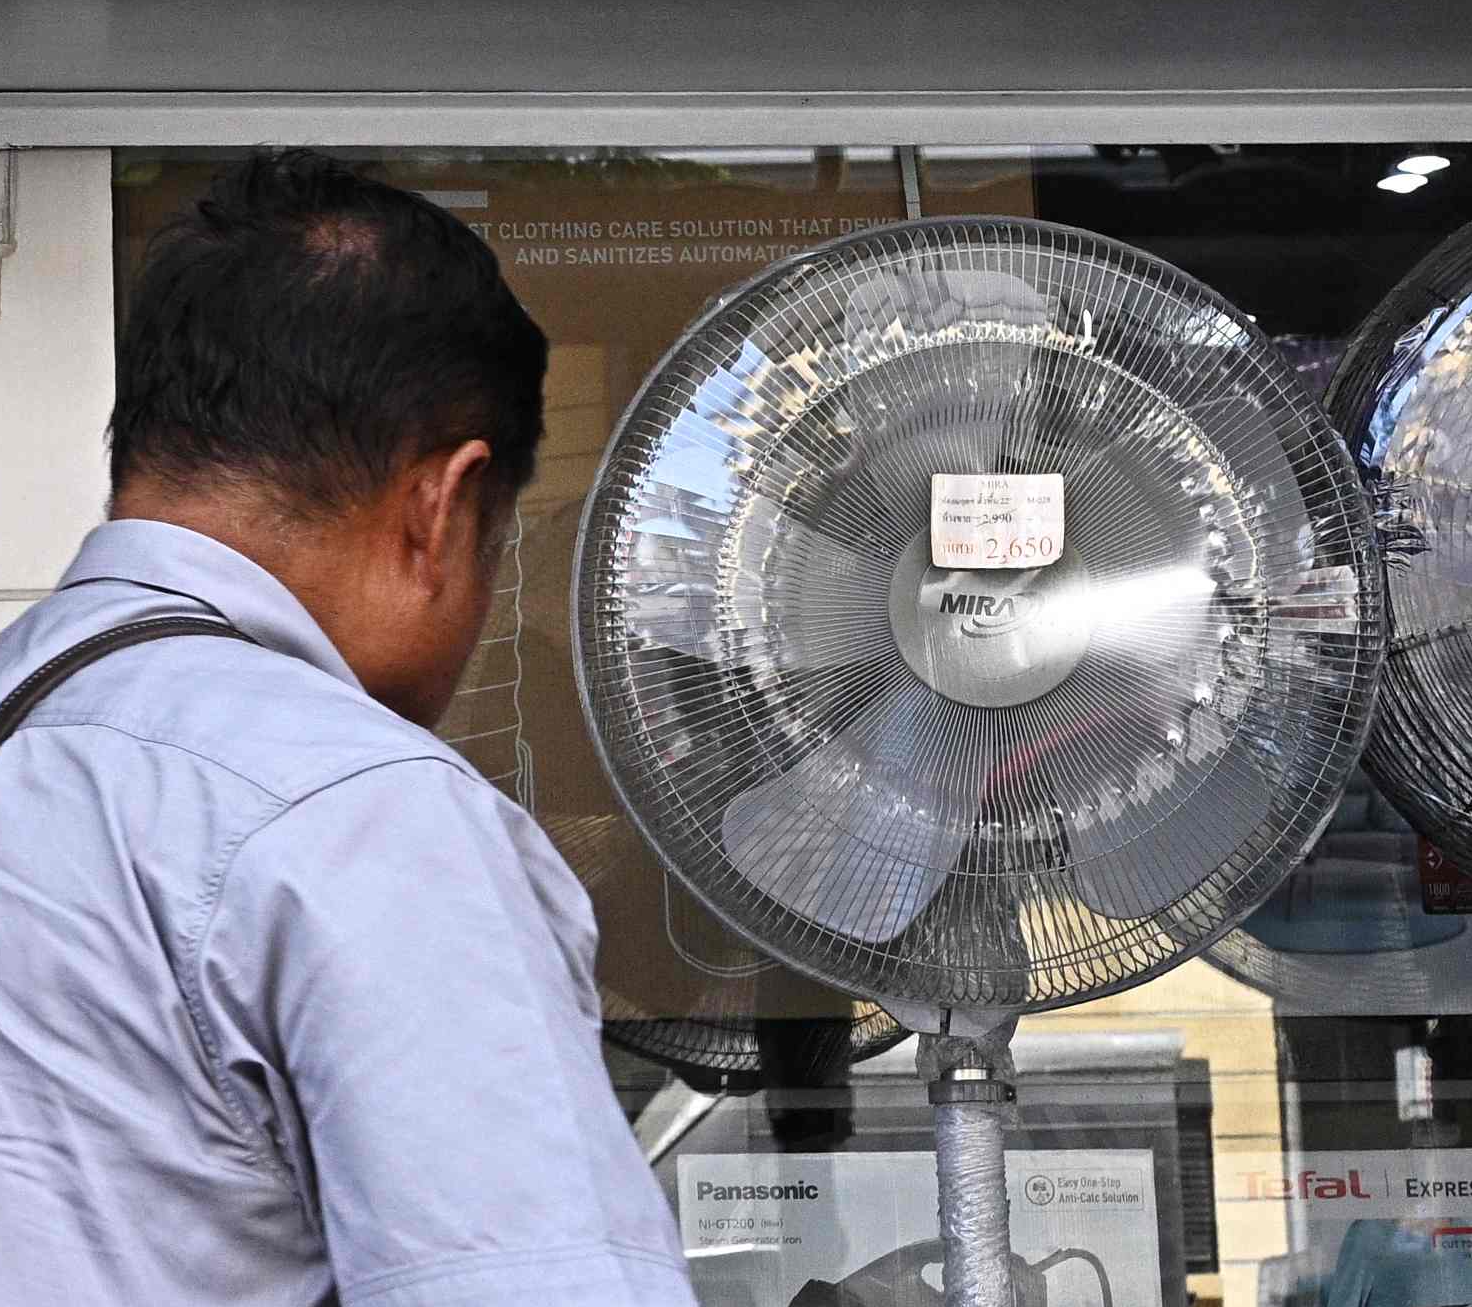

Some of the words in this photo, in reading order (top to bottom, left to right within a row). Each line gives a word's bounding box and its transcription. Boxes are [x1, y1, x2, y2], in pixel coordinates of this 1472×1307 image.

[498, 221, 603, 241] CLOTHING
[607, 220, 664, 239] CARE
[668, 219, 775, 239] SOLUTION
[781, 218, 834, 237] THAT
[514, 248, 559, 266] AND
[565, 246, 674, 266] SANITIZES
[985, 536, 1053, 565] 2,650
[939, 593, 1016, 617] MIRA
[696, 1180, 819, 1201] Panasonic
[1057, 1177, 1078, 1190] Easy
[1243, 1168, 1371, 1201] Tefal
[1059, 1192, 1100, 1203] Anti-Calc
[1102, 1192, 1139, 1204] Solution
[782, 1235, 803, 1245] Iron
